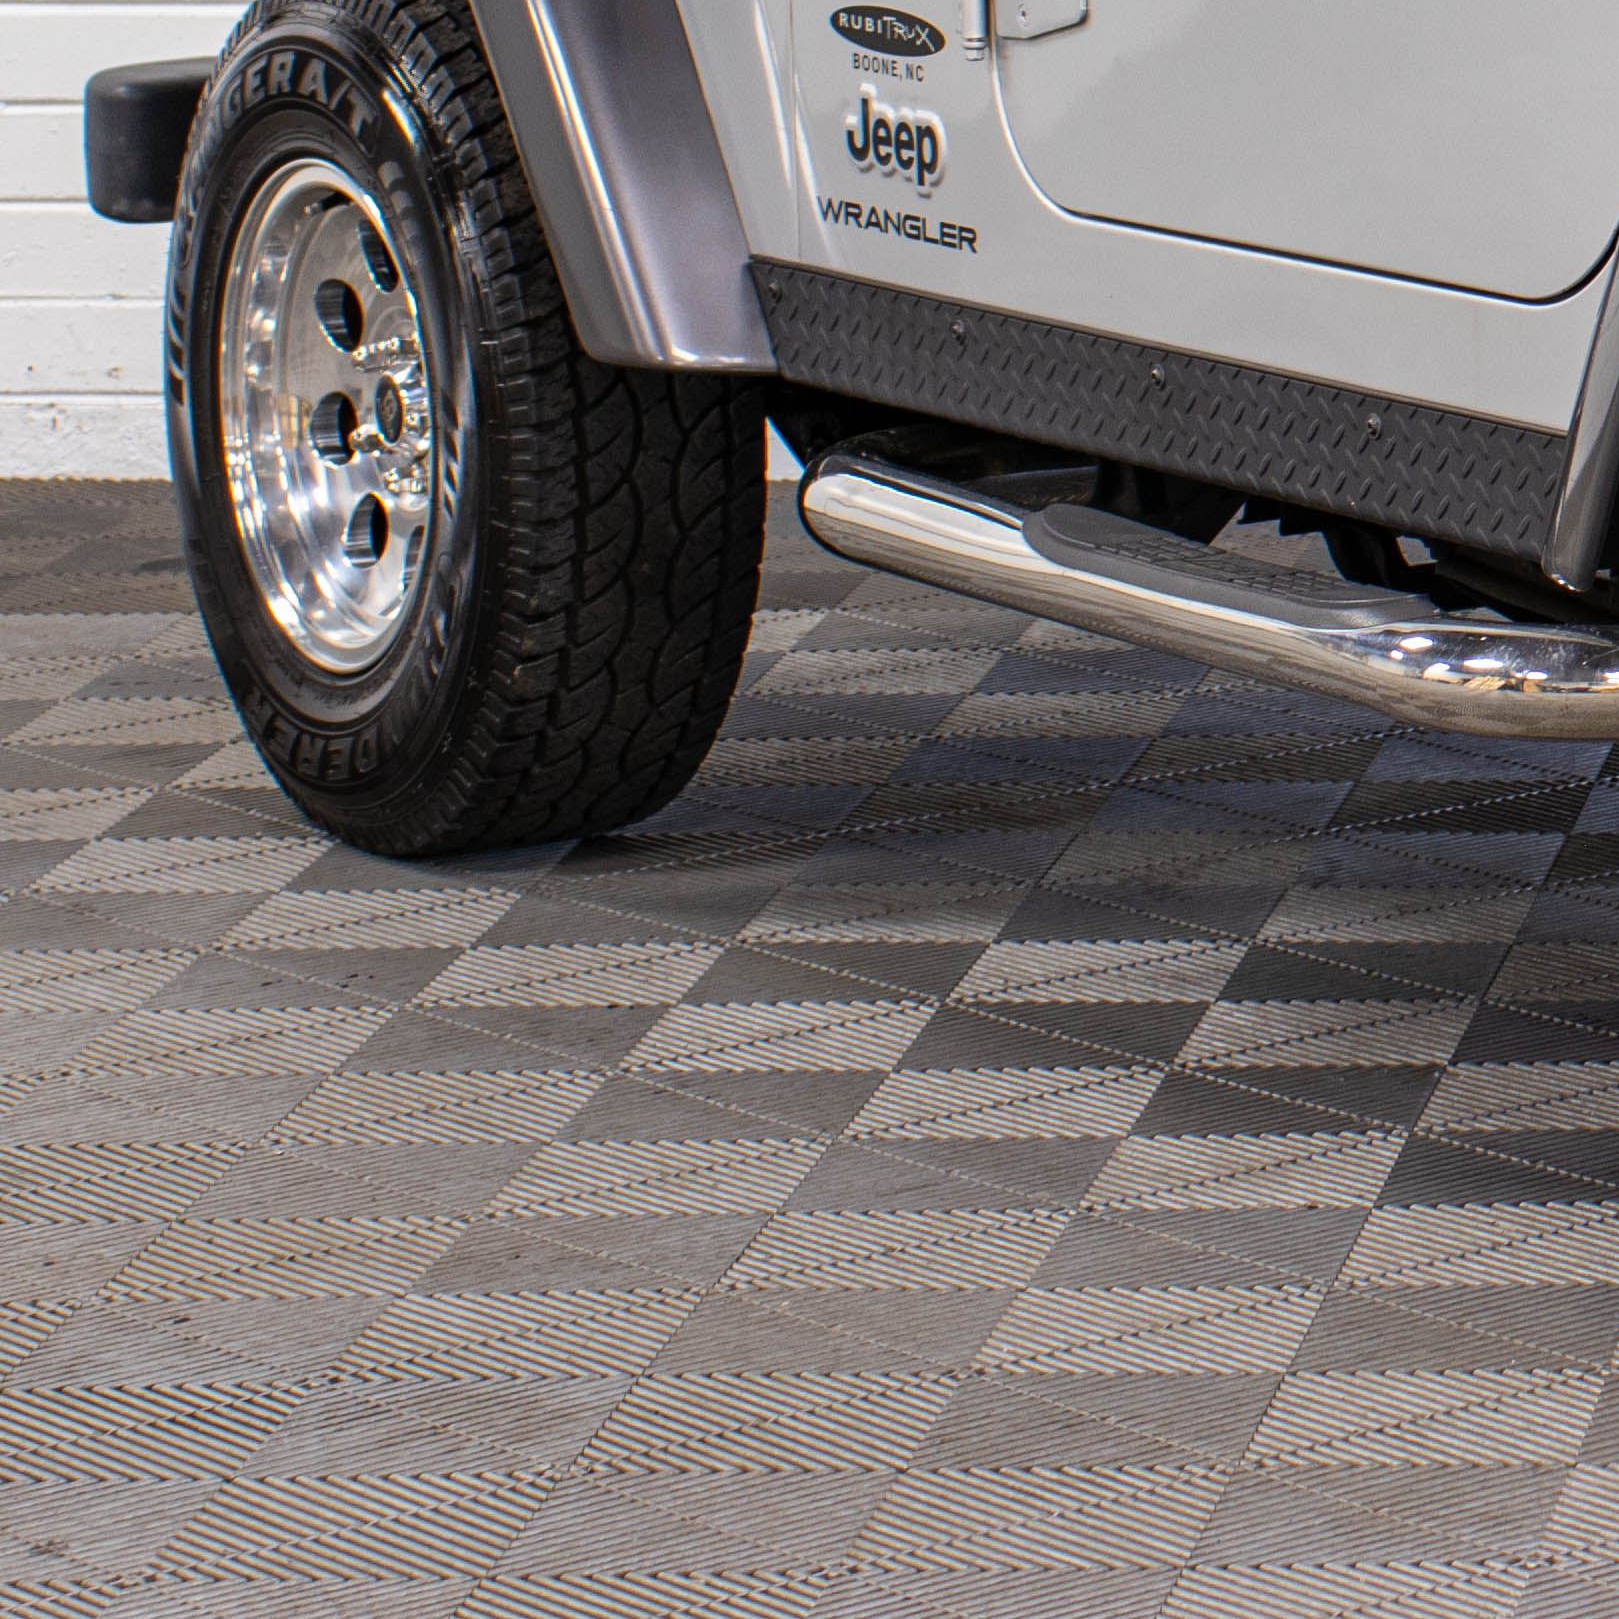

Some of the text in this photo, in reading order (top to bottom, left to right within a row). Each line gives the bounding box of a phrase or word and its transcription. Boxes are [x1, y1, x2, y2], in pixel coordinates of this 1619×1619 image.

[905, 63, 925, 83] NC
[845, 88, 943, 192] Jeep
[817, 195, 978, 253] WRANGLER
